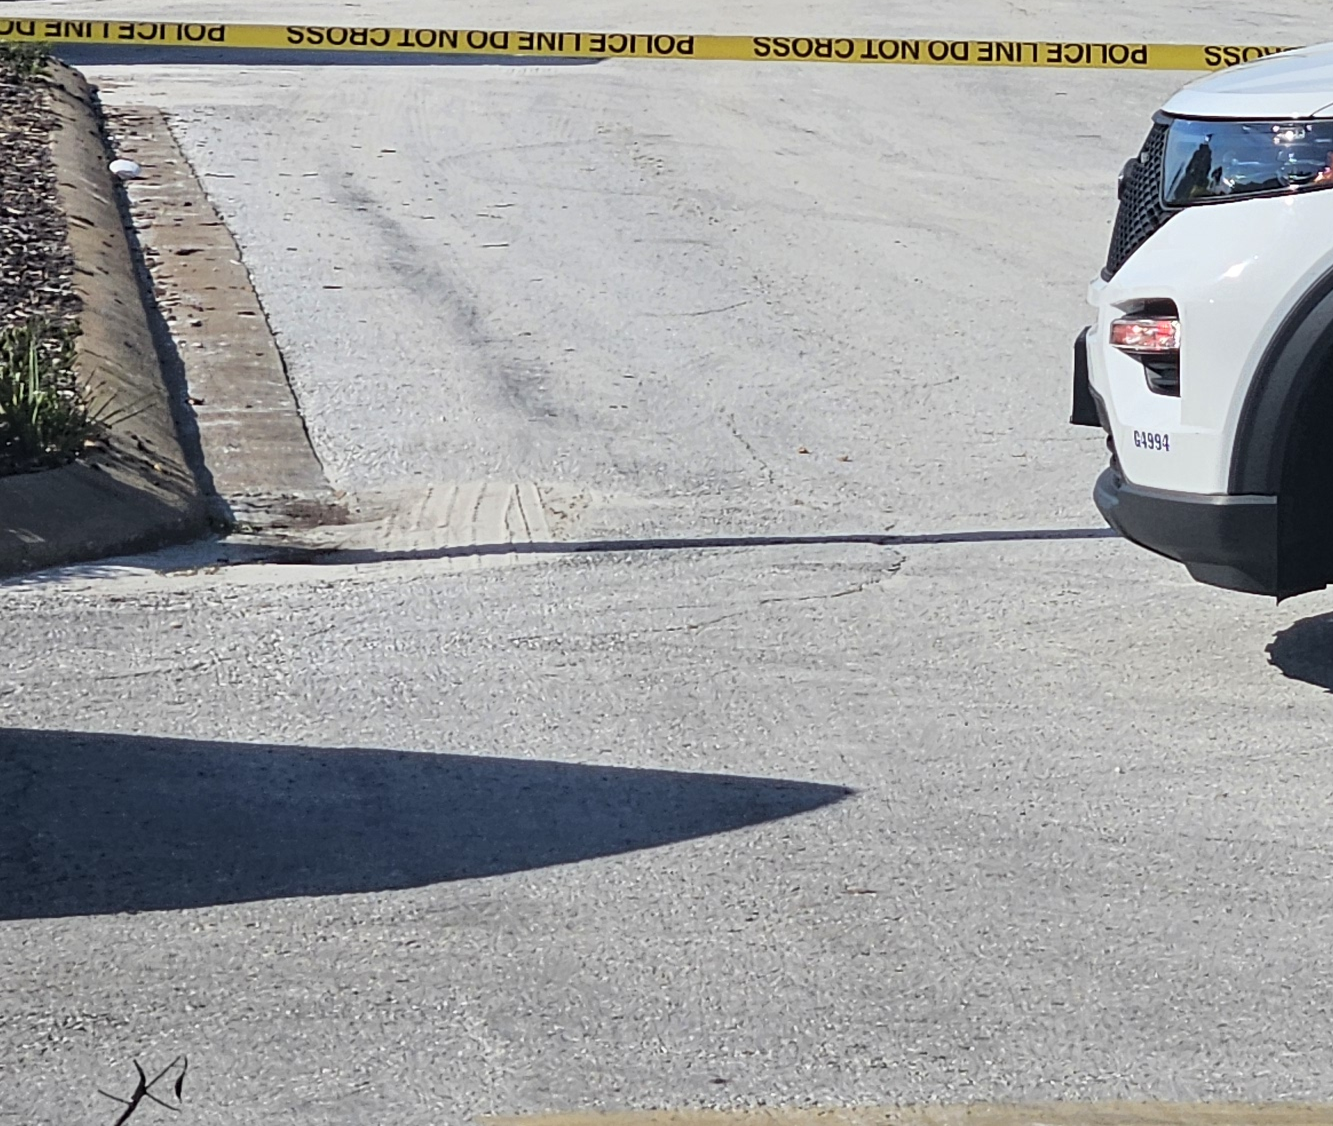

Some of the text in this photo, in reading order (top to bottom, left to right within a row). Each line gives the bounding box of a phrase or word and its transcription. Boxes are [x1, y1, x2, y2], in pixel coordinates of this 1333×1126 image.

[45, 21, 109, 40] LINE
[117, 24, 226, 42] POLICE
[286, 26, 694, 55] POLICE LINE DO NOT CROSS
[753, 36, 1148, 65] POLICE LINE DO NOT CROSS
[1133, 430, 1170, 452] G4994
